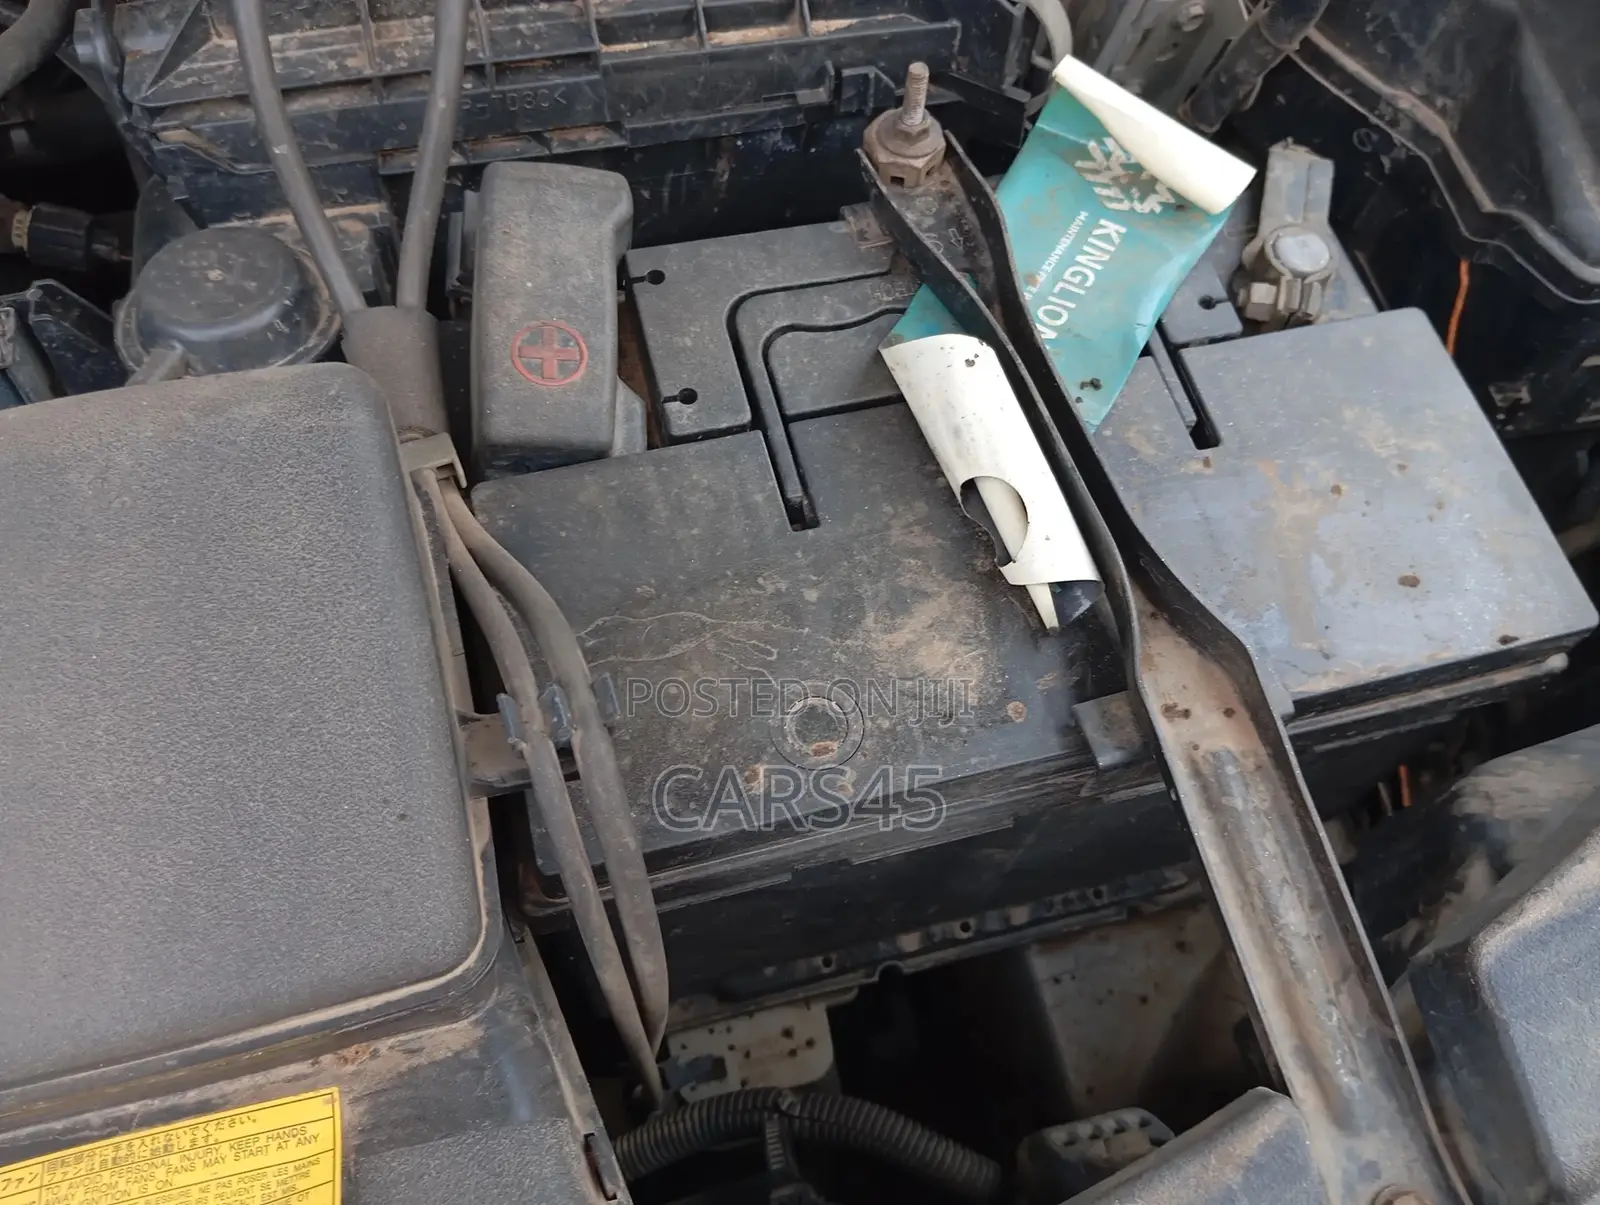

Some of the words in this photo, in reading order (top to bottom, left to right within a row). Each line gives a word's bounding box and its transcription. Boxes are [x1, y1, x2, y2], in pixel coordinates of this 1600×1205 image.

[44, 1185, 60, 1198] TO
[67, 1174, 102, 1190] AVOID
[110, 1158, 172, 1179] PERSONAL
[229, 1136, 260, 1152] KEEP
[266, 1126, 307, 1142] HANDS
[84, 1180, 119, 1197] FROM
[166, 1161, 196, 1177] FANS
[203, 1154, 227, 1169] MAY
[234, 1144, 270, 1161] START
[276, 1139, 291, 1152] AT
[296, 1133, 320, 1148] ANY
[1, 1172, 39, 1191] ファン
[216, 1180, 232, 1190] PAS
[237, 1172, 267, 1186] POSER
[272, 1166, 288, 1178] LES
[260, 1180, 272, 1191] SE
[139, 1183, 148, 1195] IS
